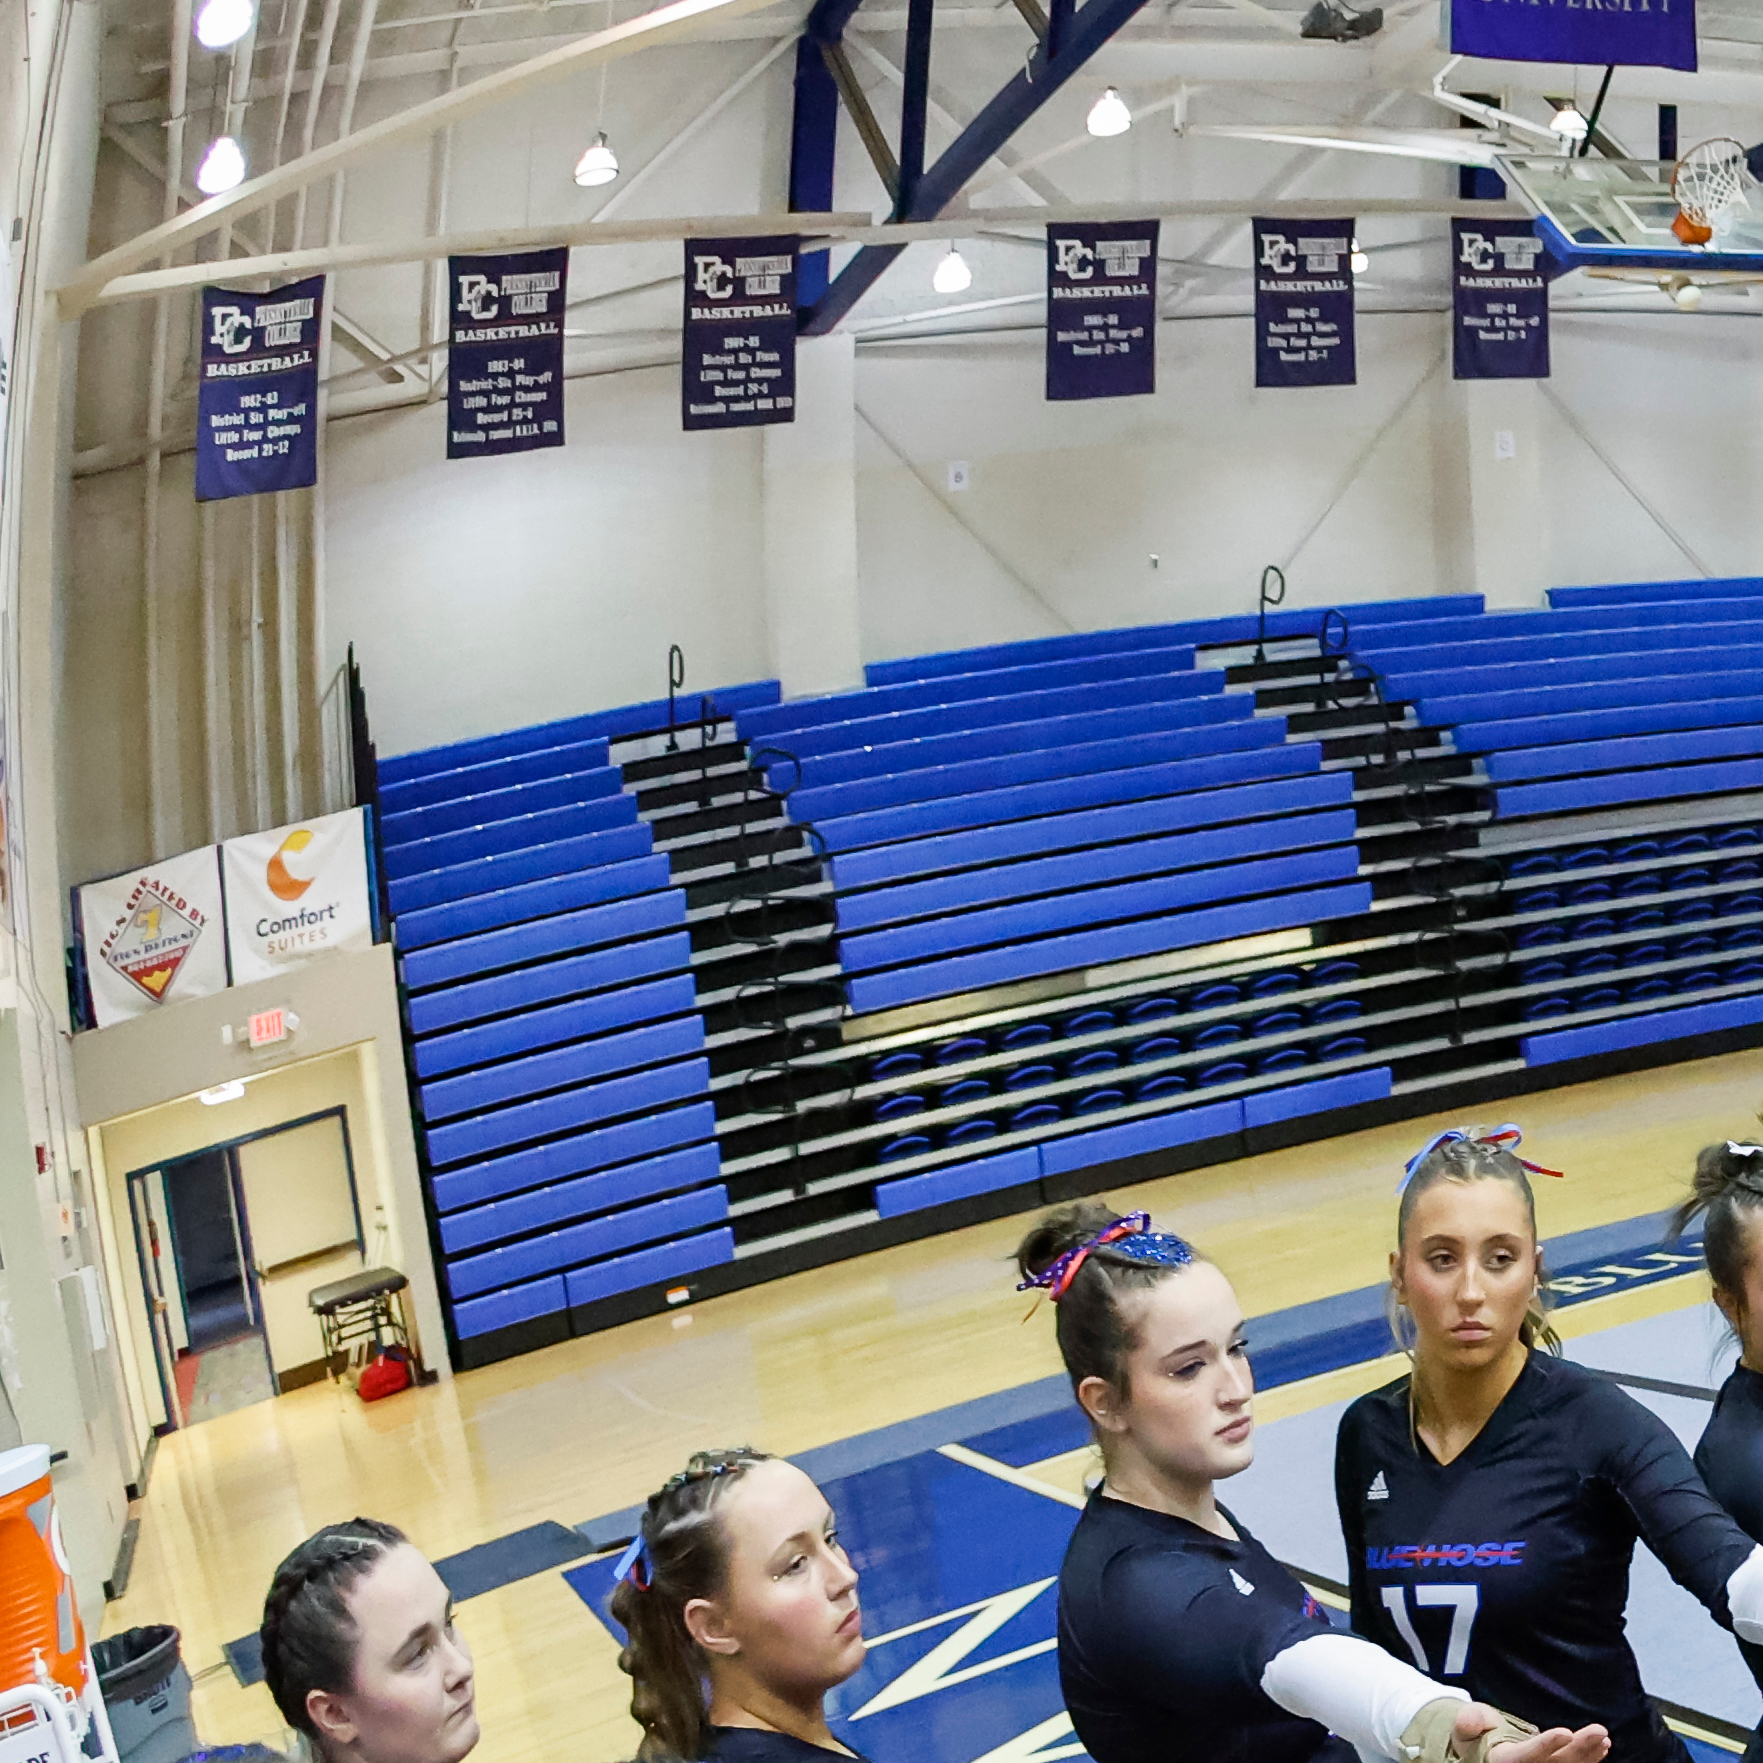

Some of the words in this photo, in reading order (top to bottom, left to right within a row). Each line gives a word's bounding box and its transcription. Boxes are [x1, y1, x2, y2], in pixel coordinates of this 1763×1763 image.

[693, 255, 734, 299] PC
[457, 274, 499, 320] PC
[690, 303, 791, 320] BASKETBALL
[210, 305, 252, 354] PC
[455, 321, 559, 343] BASKETBALL
[206, 350, 312, 377] BASKETBALL
[256, 904, 337, 938] Comfort
[267, 927, 328, 954] SUITES
[1421, 1541, 1528, 1568] HOSE
[1380, 1583, 1483, 1676] 17
